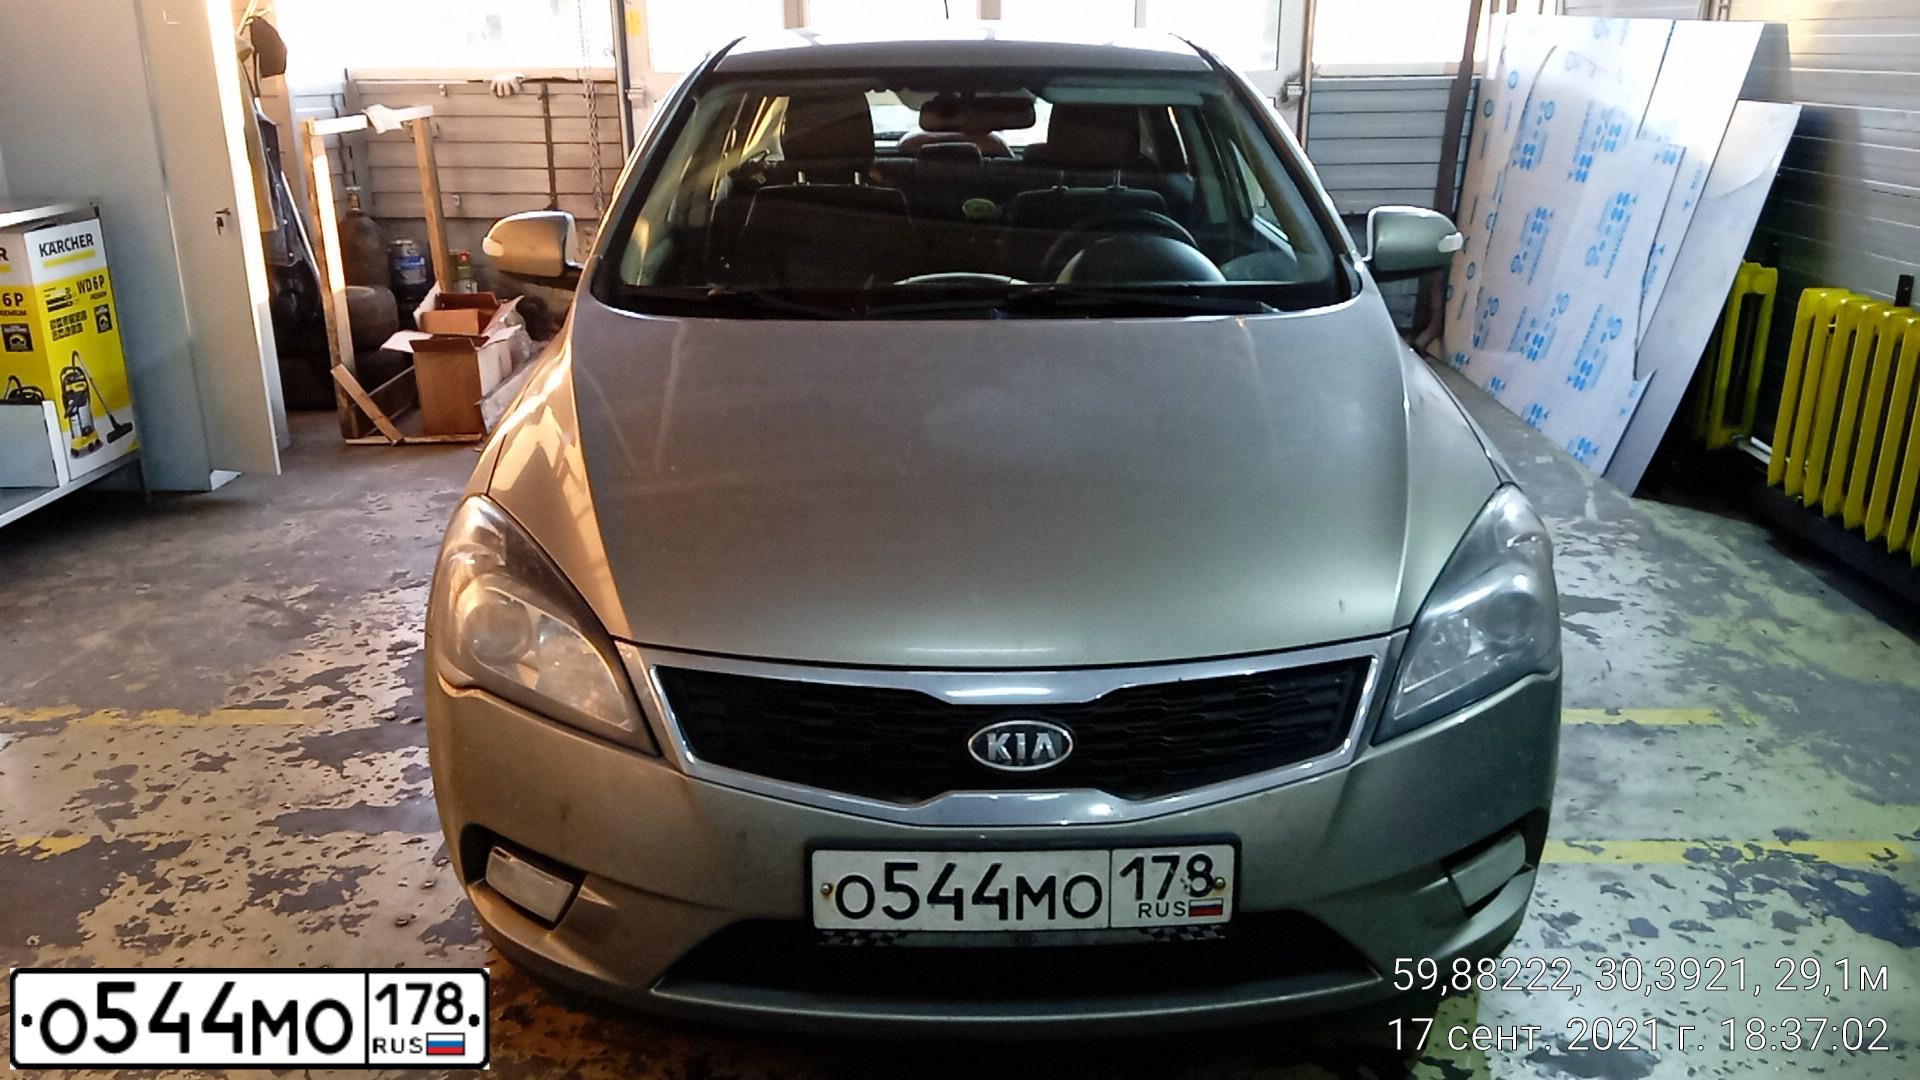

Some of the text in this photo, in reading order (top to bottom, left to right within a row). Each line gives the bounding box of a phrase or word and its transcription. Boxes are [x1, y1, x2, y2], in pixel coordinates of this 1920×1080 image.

[76, 279, 91, 294] WD
[2, 292, 23, 307] 6 P
[986, 732, 1057, 761] KIA
[1119, 853, 1215, 902] 178
[1137, 900, 1187, 919] RUS
